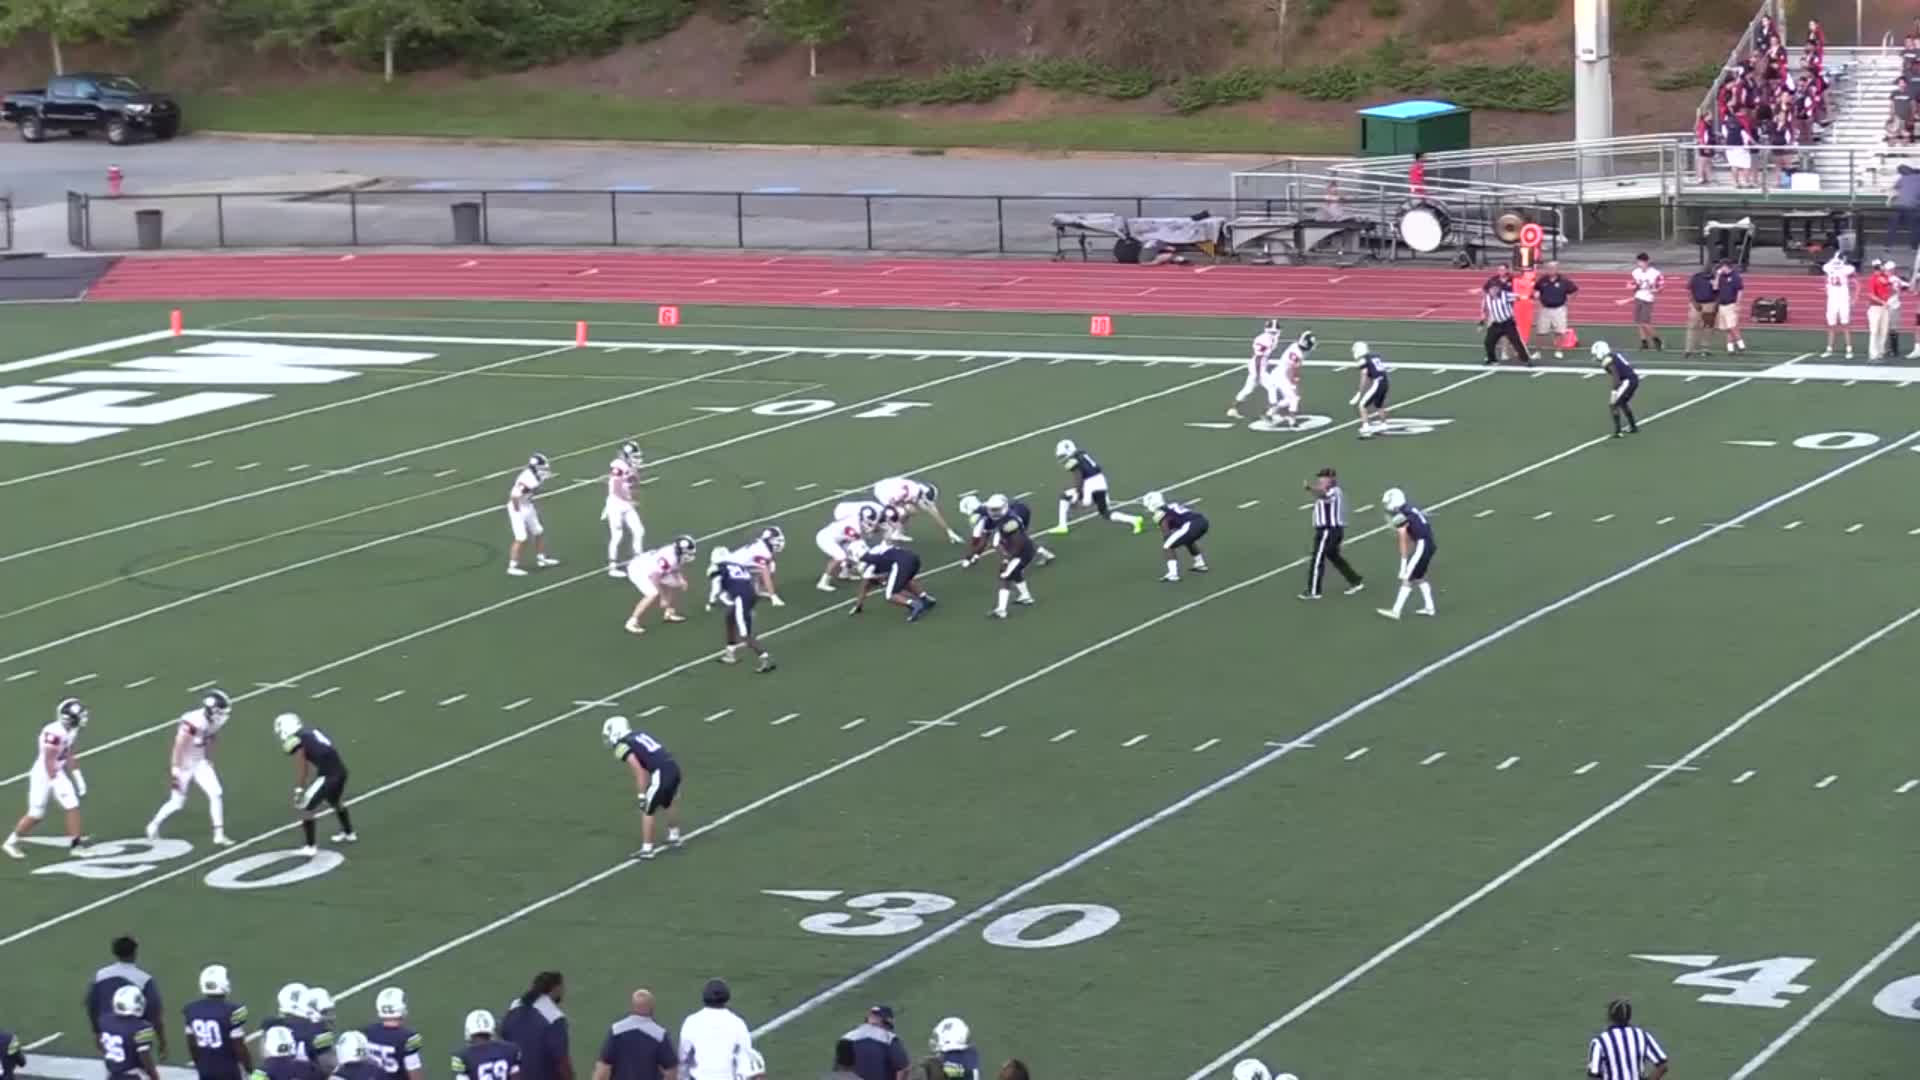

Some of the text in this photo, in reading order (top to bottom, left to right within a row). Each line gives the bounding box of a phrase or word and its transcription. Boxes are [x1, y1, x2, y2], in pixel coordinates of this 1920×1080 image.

[29, 837, 345, 890] 20
[799, 889, 1121, 951] 30
[192, 1019, 223, 1048] 90
[366, 1041, 399, 1073] 55
